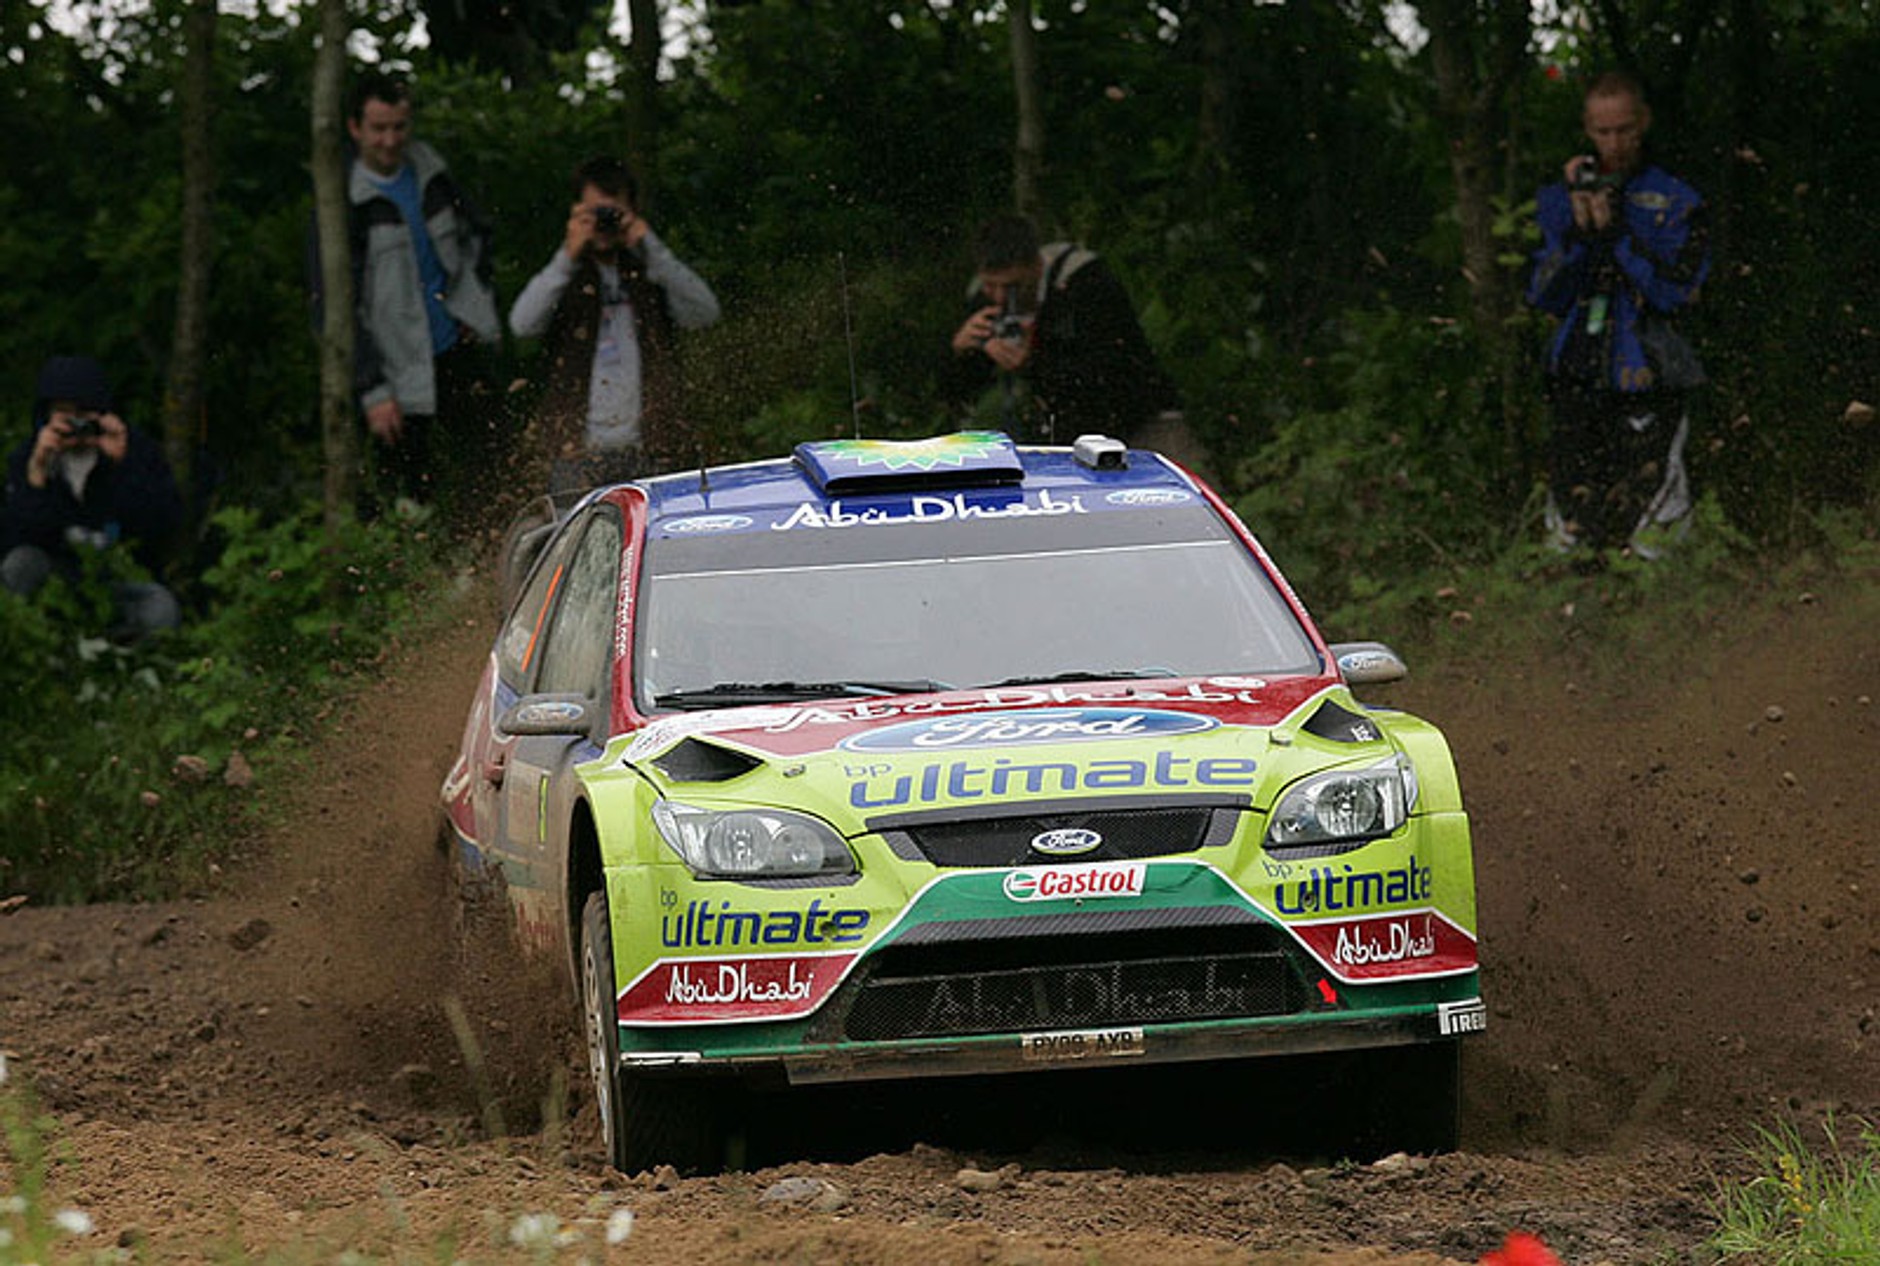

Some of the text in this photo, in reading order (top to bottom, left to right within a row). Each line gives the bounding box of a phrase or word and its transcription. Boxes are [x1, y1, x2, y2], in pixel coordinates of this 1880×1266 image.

[912, 711, 1146, 746] Ford
[843, 763, 892, 778] bp
[850, 751, 1257, 808] ultimate
[1040, 867, 1136, 897] Castrol
[1263, 861, 1292, 879] bp
[1276, 855, 1432, 914] ultimate
[660, 883, 678, 911] bp
[662, 898, 871, 947] ultimate
